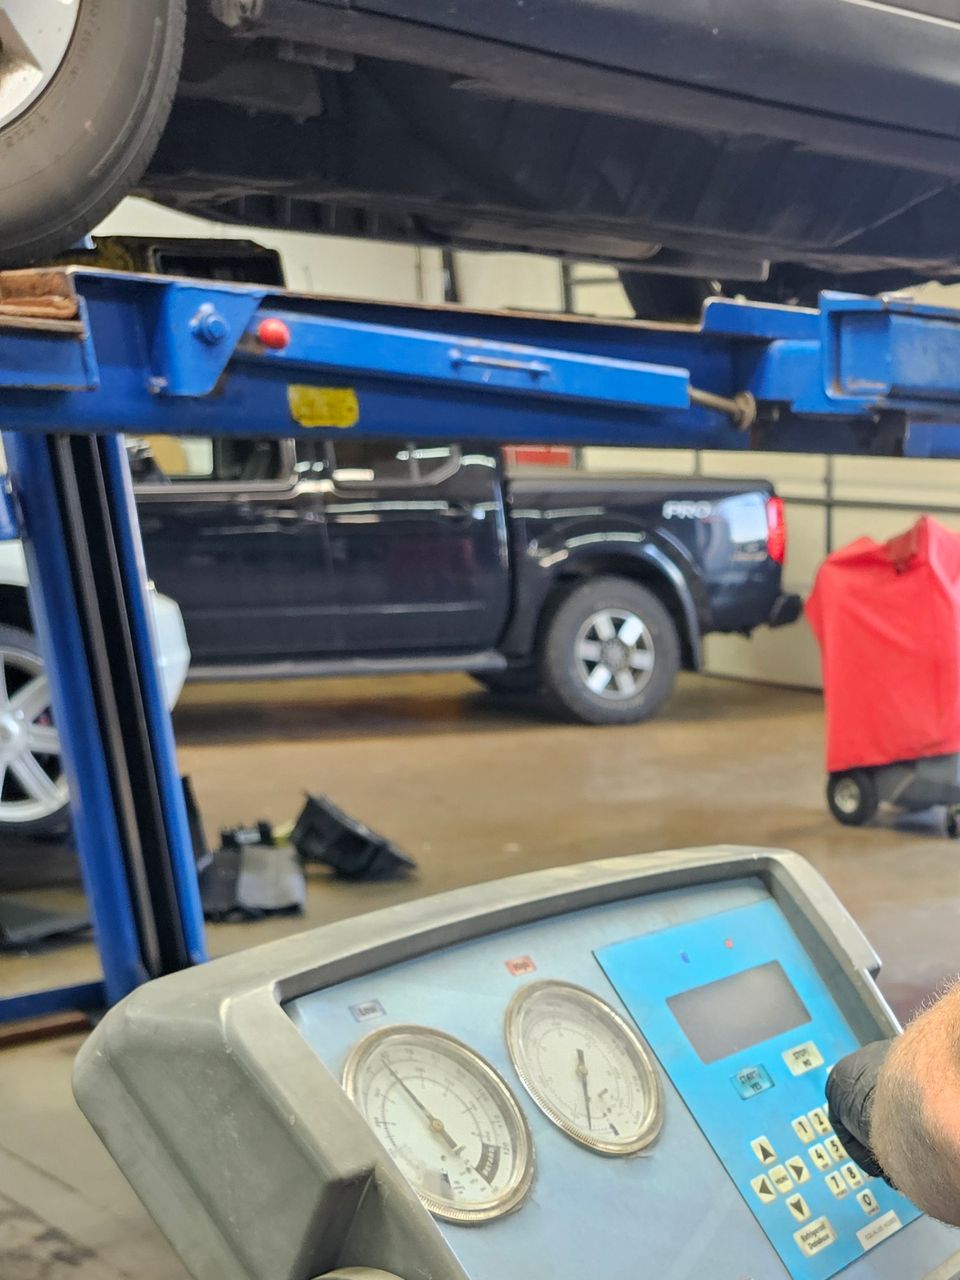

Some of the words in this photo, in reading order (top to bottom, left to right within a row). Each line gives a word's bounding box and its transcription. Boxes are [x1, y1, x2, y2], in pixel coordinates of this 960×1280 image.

[797, 1121, 808, 1134] 1
[813, 1113, 824, 1126] 2
[814, 1149, 825, 1160] 4
[830, 1140, 839, 1152] 5
[831, 1176, 840, 1189] 7
[846, 1166, 856, 1179] 8
[862, 1193, 872, 1206] 0
